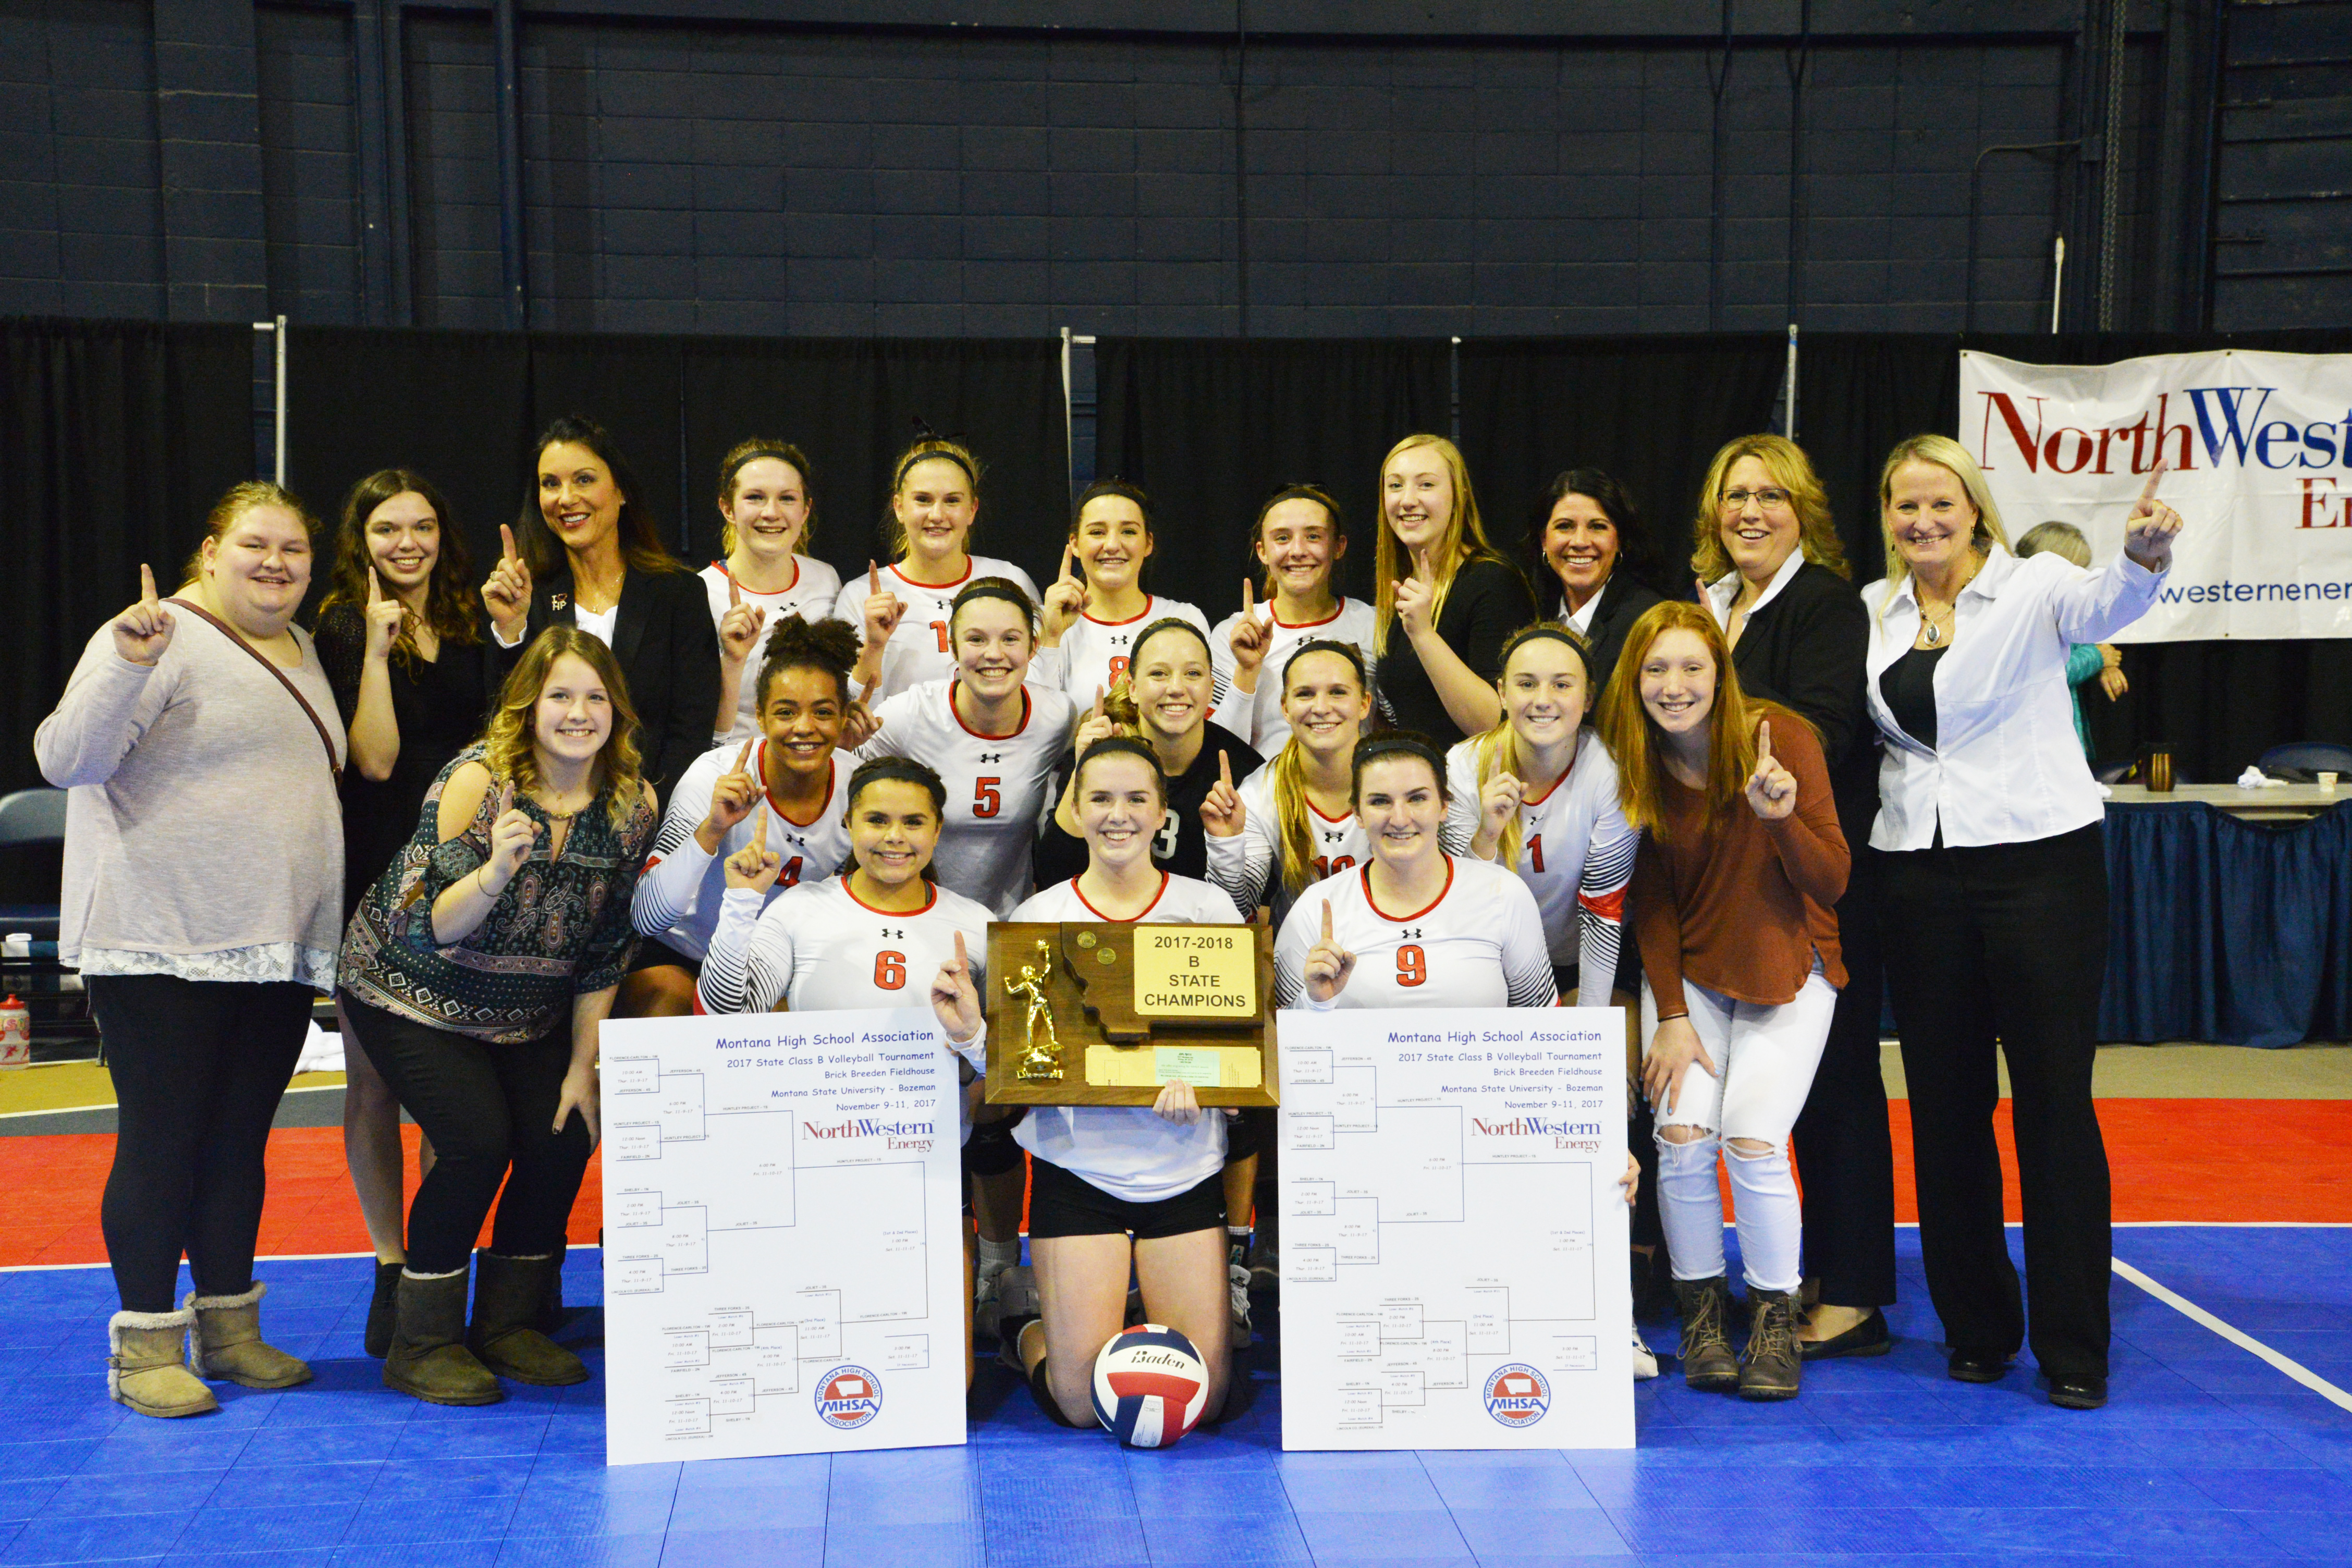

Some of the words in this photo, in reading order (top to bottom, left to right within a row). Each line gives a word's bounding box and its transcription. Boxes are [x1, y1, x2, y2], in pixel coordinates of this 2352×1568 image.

[1109, 656, 1130, 689] 8
[972, 777, 1001, 818] 5
[1527, 834, 1545, 874] 1
[1155, 936, 1233, 949] 2017-2018
[1189, 956, 1199, 967] B
[1396, 944, 1427, 987] 9
[874, 950, 906, 990] 6
[1169, 975, 1220, 987] STATE
[1144, 994, 1246, 1008] CHAMPIONS
[716, 1038, 771, 1049] Montana
[778, 1035, 806, 1049] High
[813, 1033, 854, 1045] School
[862, 1030, 934, 1043] Association
[1388, 1032, 1441, 1043] Montana
[1448, 1032, 1476, 1045] High
[1483, 1031, 1523, 1042] School
[1530, 1031, 1601, 1042] Association
[727, 1059, 751, 1068] 2017
[756, 1057, 783, 1067] State
[789, 1057, 813, 1065] Class
[818, 1056, 824, 1064] B
[829, 1054, 874, 1065] Volleyball
[879, 1052, 934, 1062] Tournament
[1399, 1054, 1422, 1062] 2017
[1427, 1053, 1453, 1061] State
[1459, 1053, 1482, 1061] Class
[1497, 1052, 1542, 1062] Volleyball
[1547, 1052, 1602, 1060] Tournament
[825, 1071, 847, 1079] Brick
[851, 1069, 886, 1078] Breeden
[890, 1068, 935, 1076] Fieldhouse
[771, 1089, 808, 1098] Montana
[812, 1087, 837, 1096] State
[841, 1086, 885, 1095] University
[899, 1084, 936, 1092] Bozeman
[1510, 1084, 1553, 1094] University
[837, 1101, 879, 1111] November
[884, 1100, 909, 1110] 9-11,
[914, 1099, 936, 1108] 2017
[1552, 1100, 1577, 1109] 9-11,
[802, 1119, 934, 1140] NorthWestern
[1471, 1117, 1602, 1136] NorthWestern
[887, 1137, 934, 1153] Energy
[1555, 1136, 1601, 1153] Energy
[1131, 1351, 1185, 1369] Baden
[817, 1371, 840, 1402] MONTANA
[862, 1372, 879, 1399] SCHOOL
[1487, 1369, 1508, 1399] MONTANA
[1530, 1371, 1548, 1399] SCHOOL
[819, 1399, 879, 1417] MHSA
[1488, 1398, 1547, 1414] MHSA
[826, 1412, 872, 1427] ASSOCIATION
[1495, 1411, 1540, 1425] ASSOCIATION
